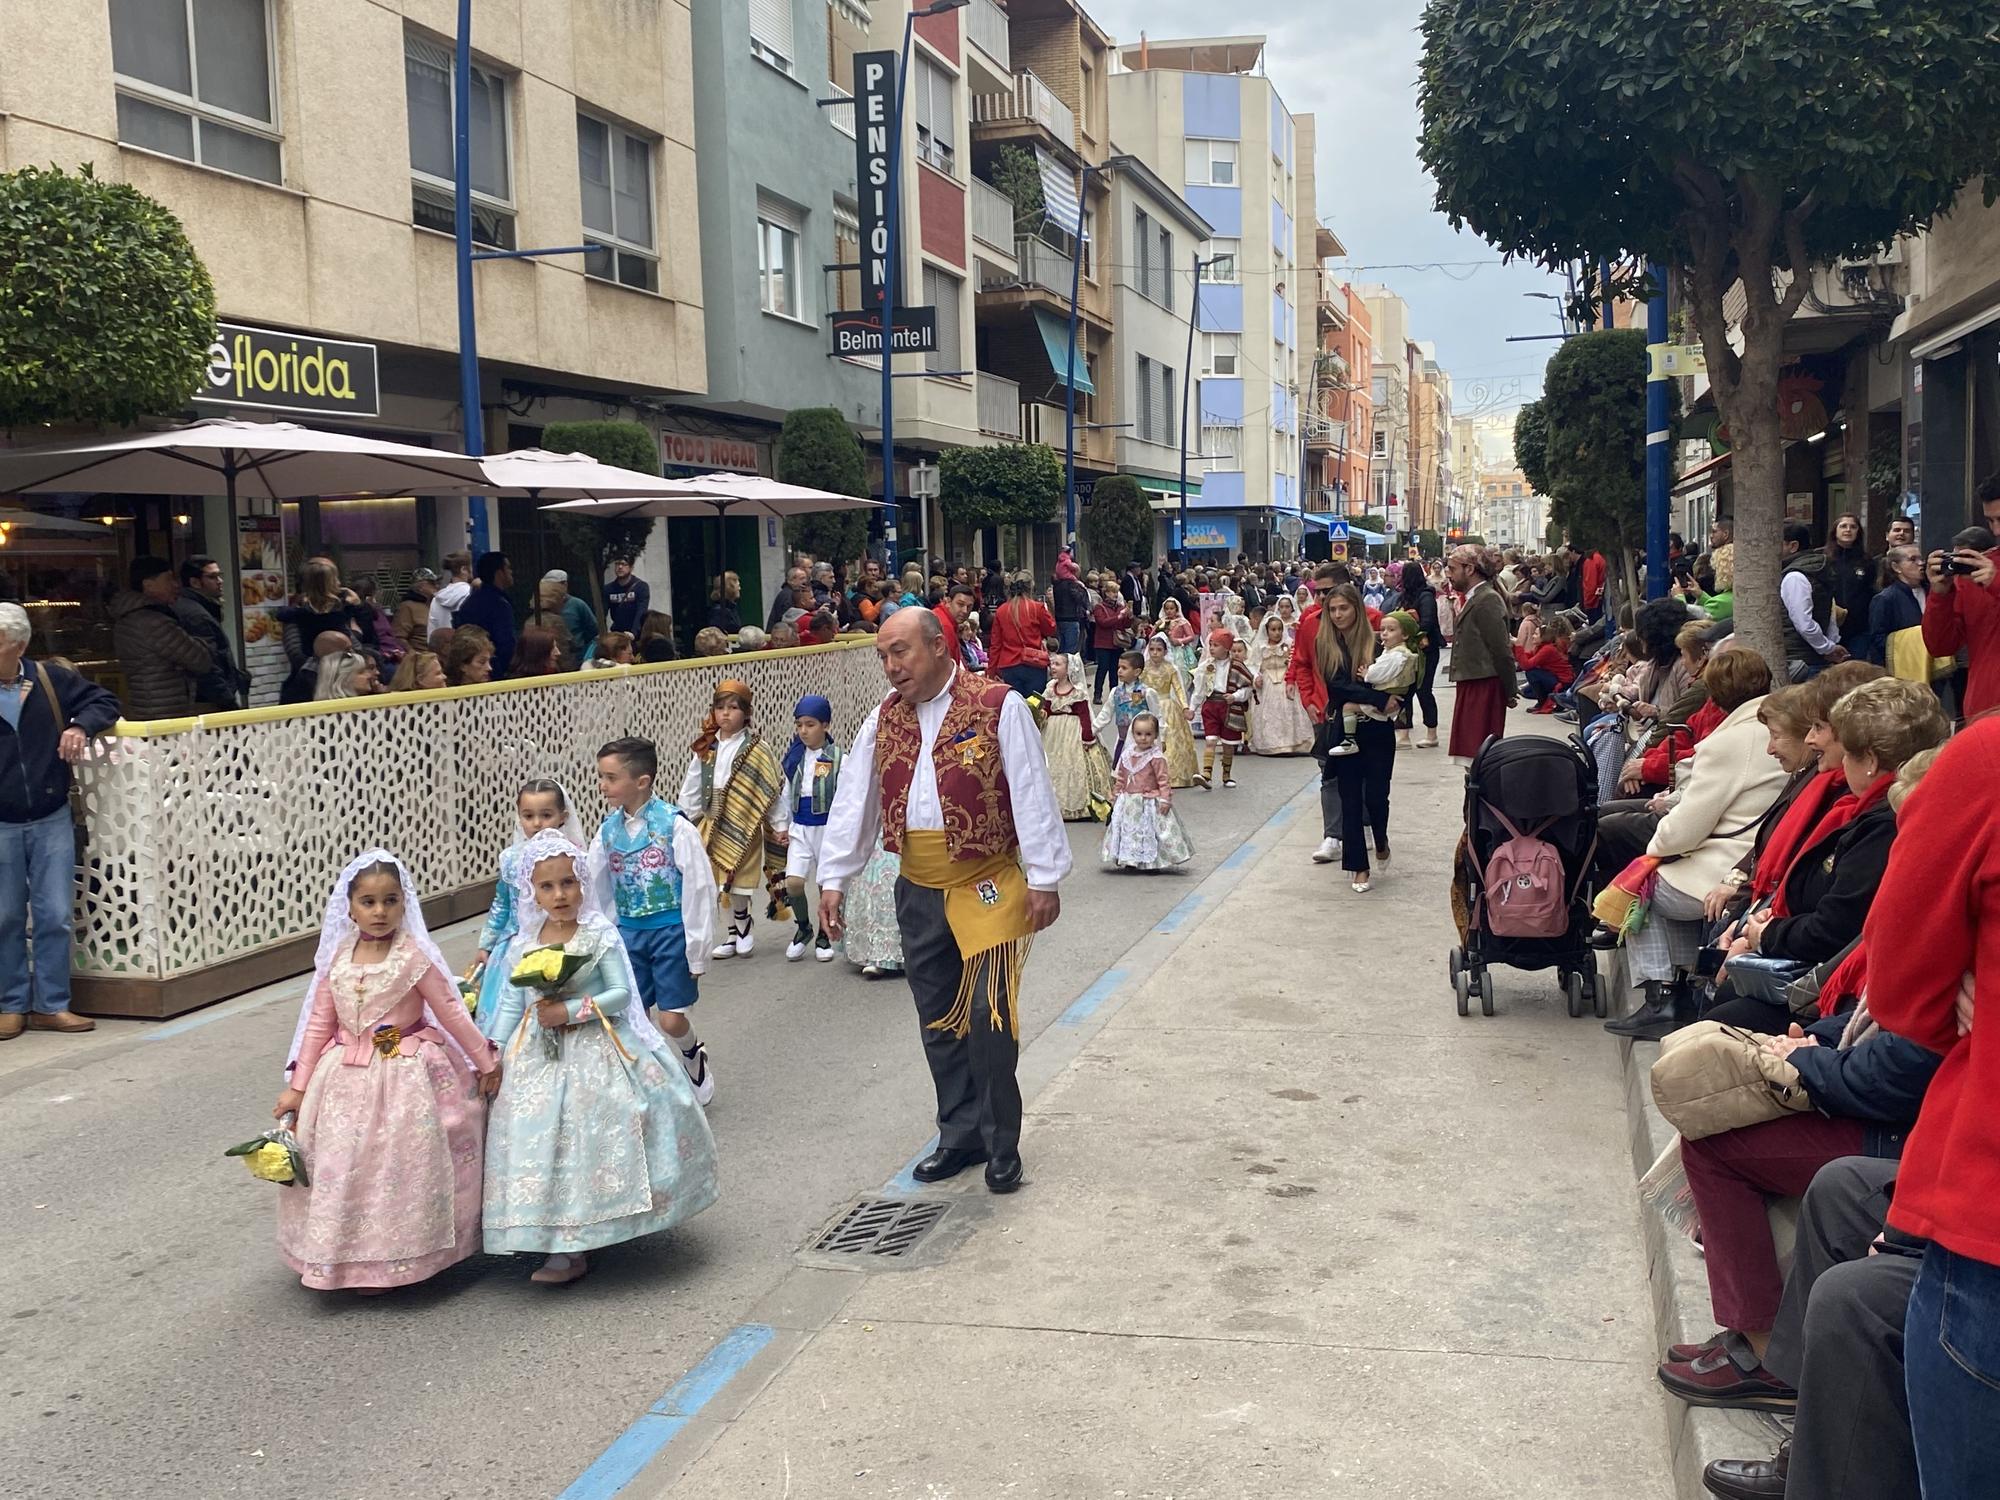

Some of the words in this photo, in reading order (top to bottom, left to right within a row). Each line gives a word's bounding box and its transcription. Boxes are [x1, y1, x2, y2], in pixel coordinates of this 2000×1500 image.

[866, 63, 888, 285] PENSIÓN
[839, 328, 920, 351] Belmnte
[664, 435, 705, 463] TODO
[711, 441, 757, 469] HOGAR
